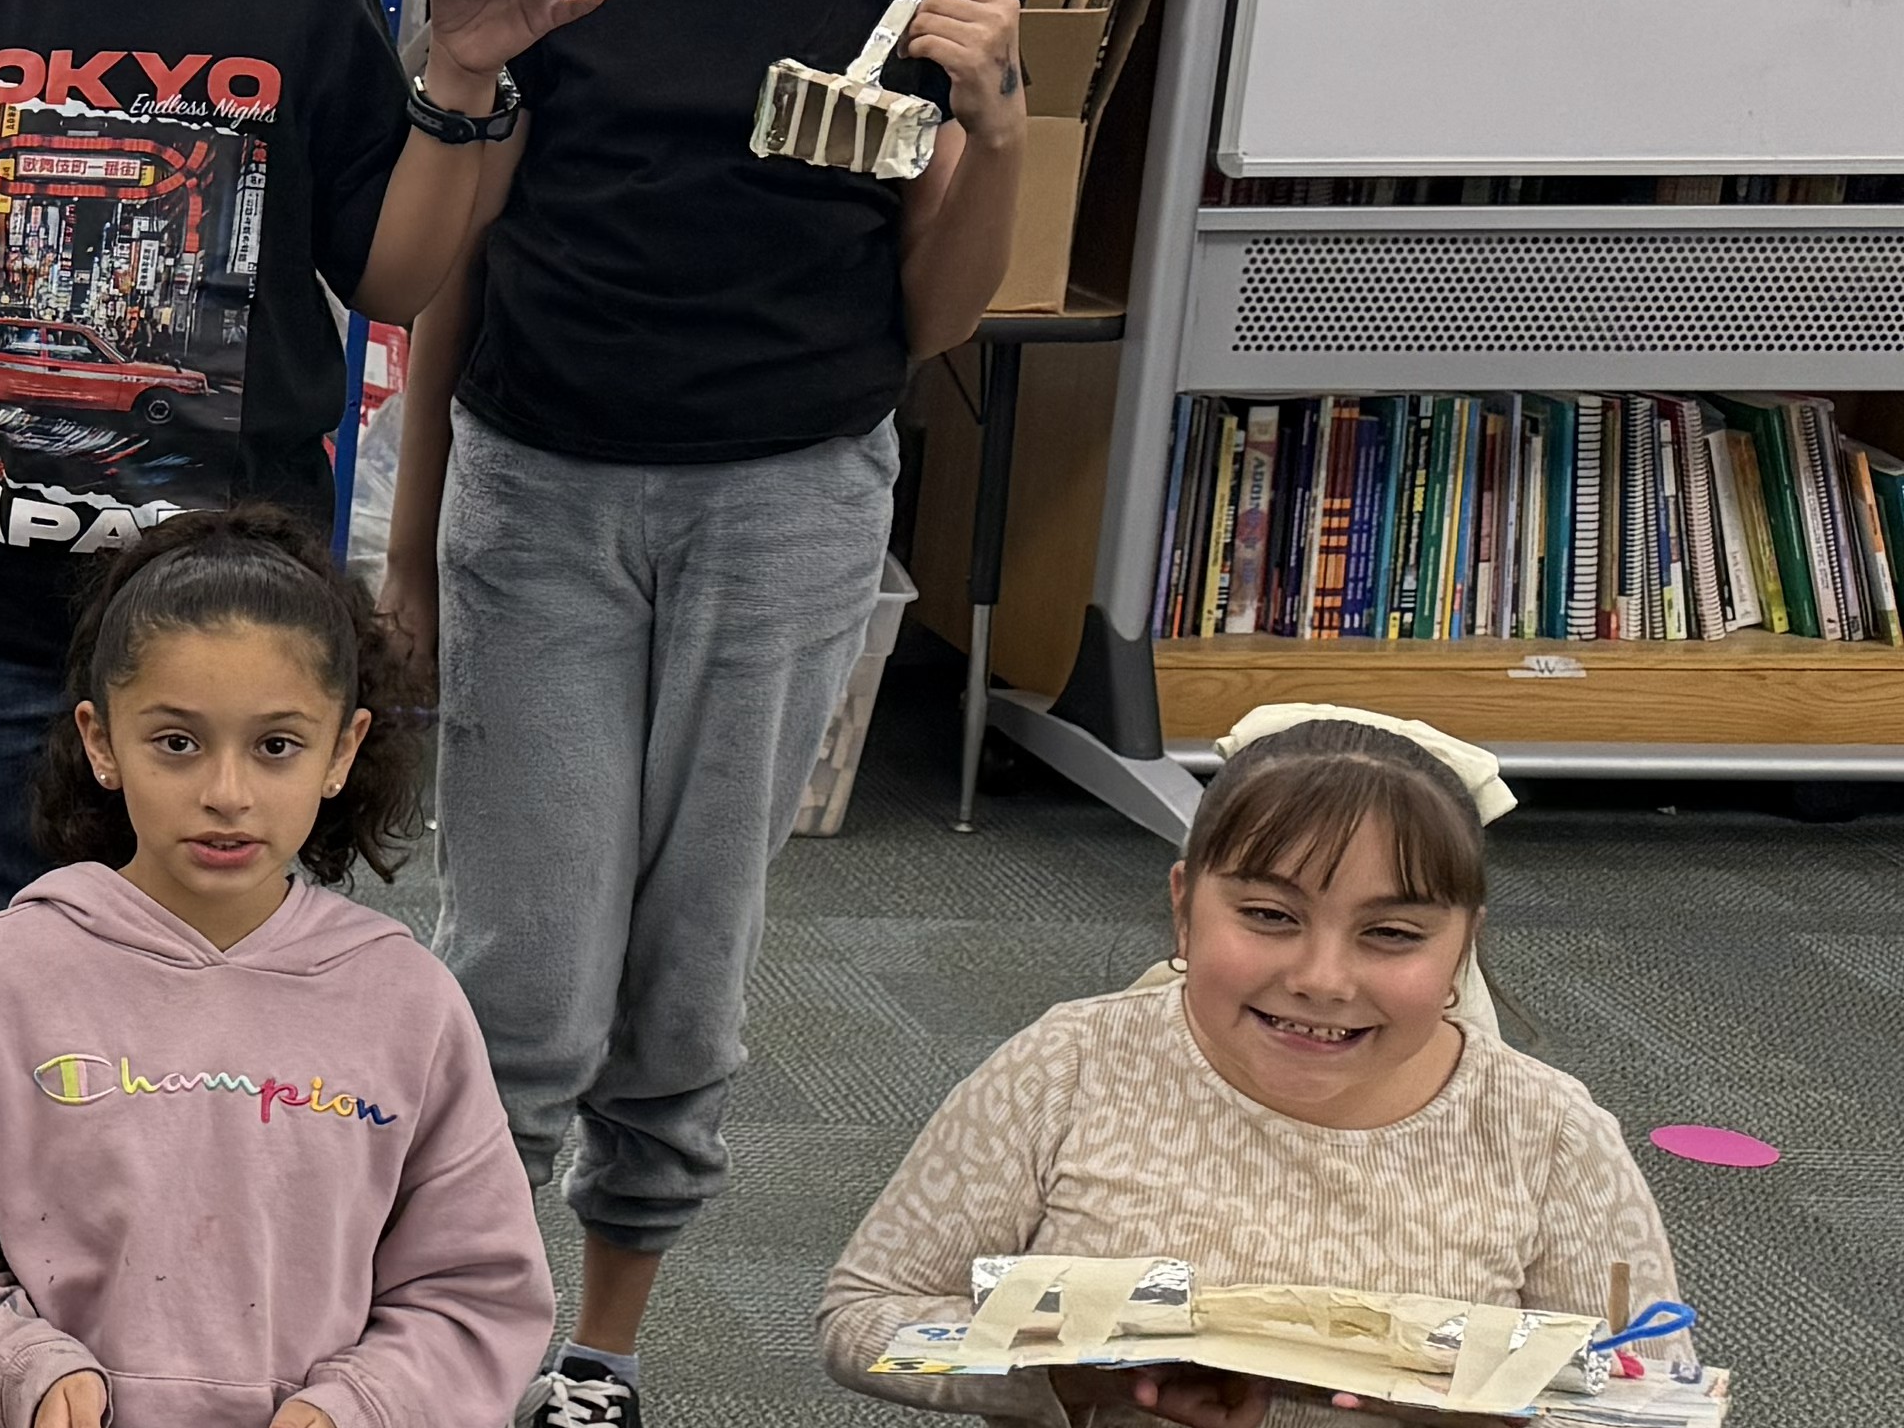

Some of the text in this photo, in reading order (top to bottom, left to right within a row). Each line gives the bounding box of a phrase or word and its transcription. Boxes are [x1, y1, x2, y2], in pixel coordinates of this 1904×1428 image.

[129, 93, 277, 129] Endless Nights
[33, 1052, 398, 1126] Champion
